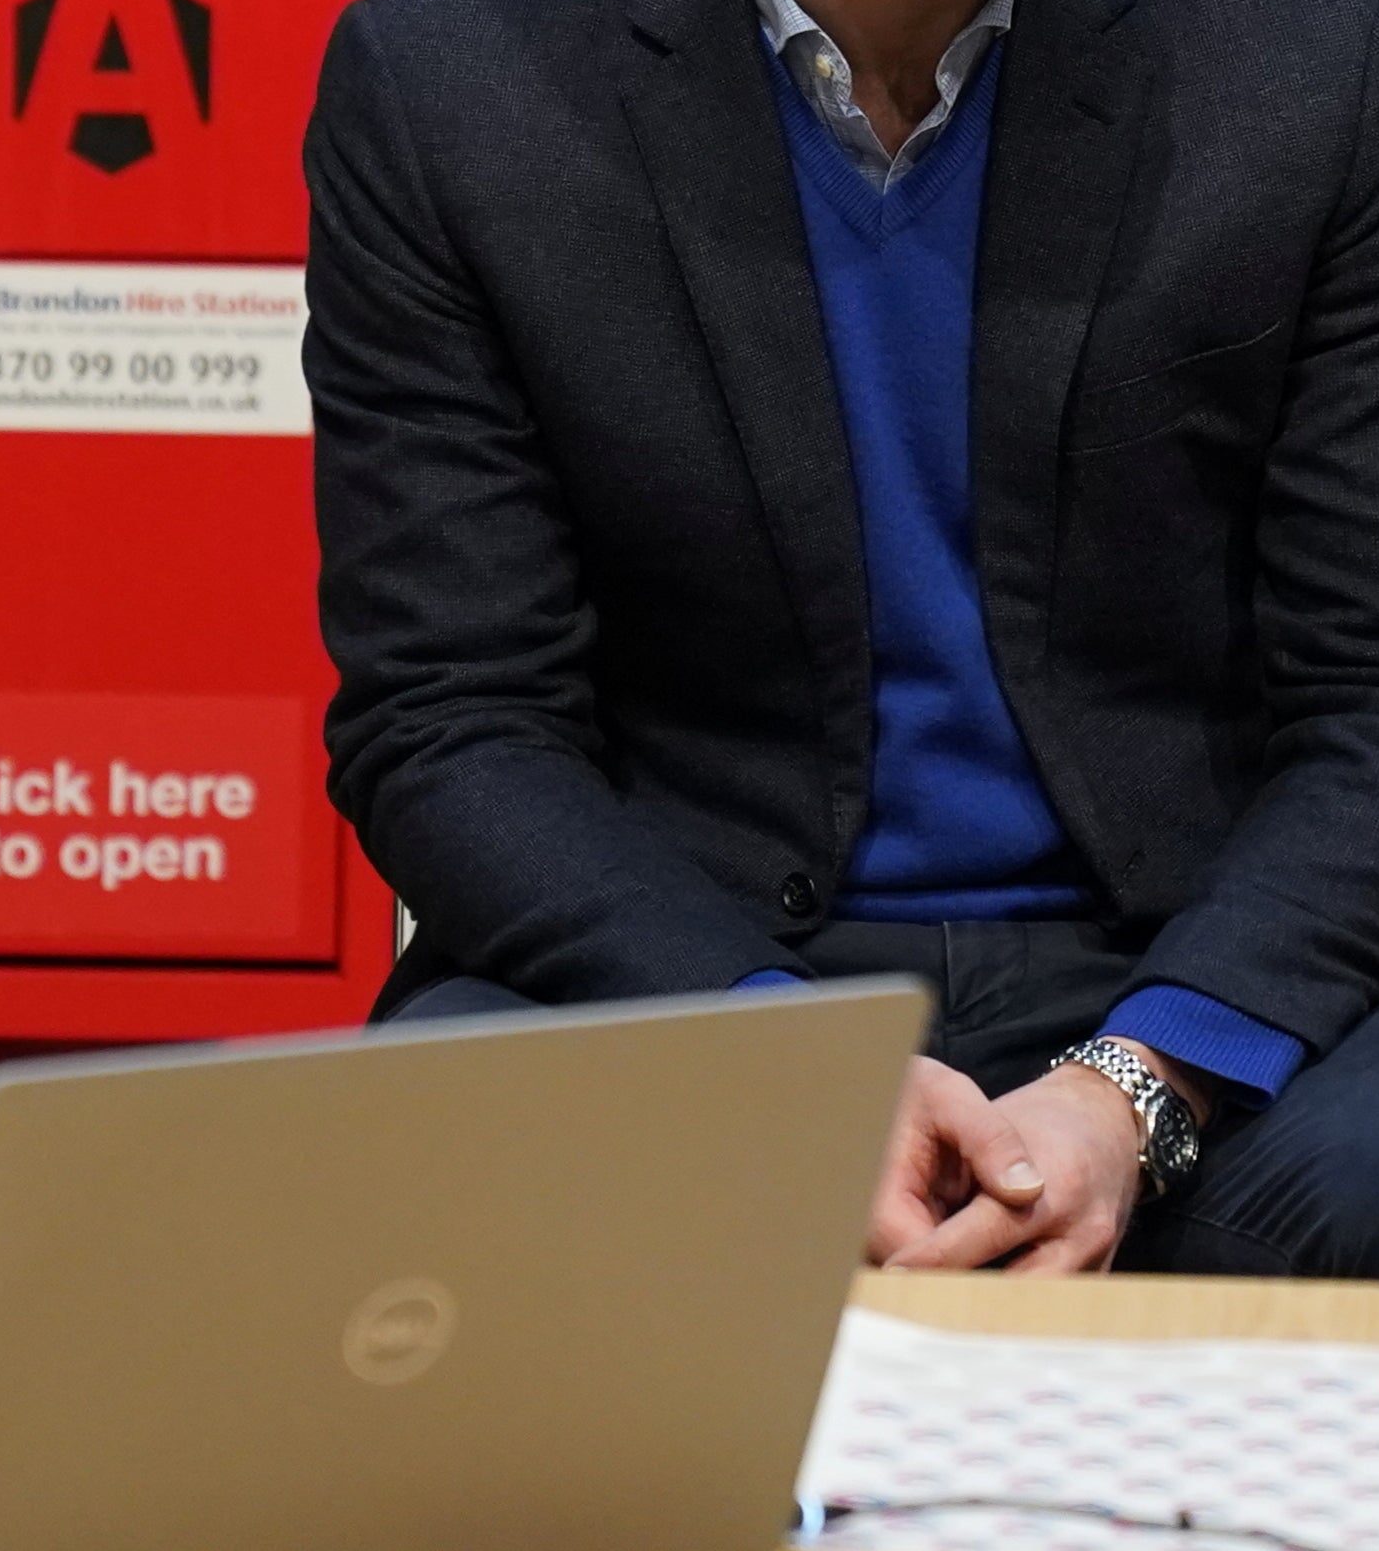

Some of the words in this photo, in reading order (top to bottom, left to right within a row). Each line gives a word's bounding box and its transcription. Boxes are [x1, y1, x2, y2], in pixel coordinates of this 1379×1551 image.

[125, 289, 186, 315] Hire
[193, 290, 299, 317] Station
[69, 351, 114, 382] 99
[128, 352, 175, 383] 00
[190, 353, 261, 385] 999
[108, 758, 256, 819] here
[58, 832, 226, 892] open
